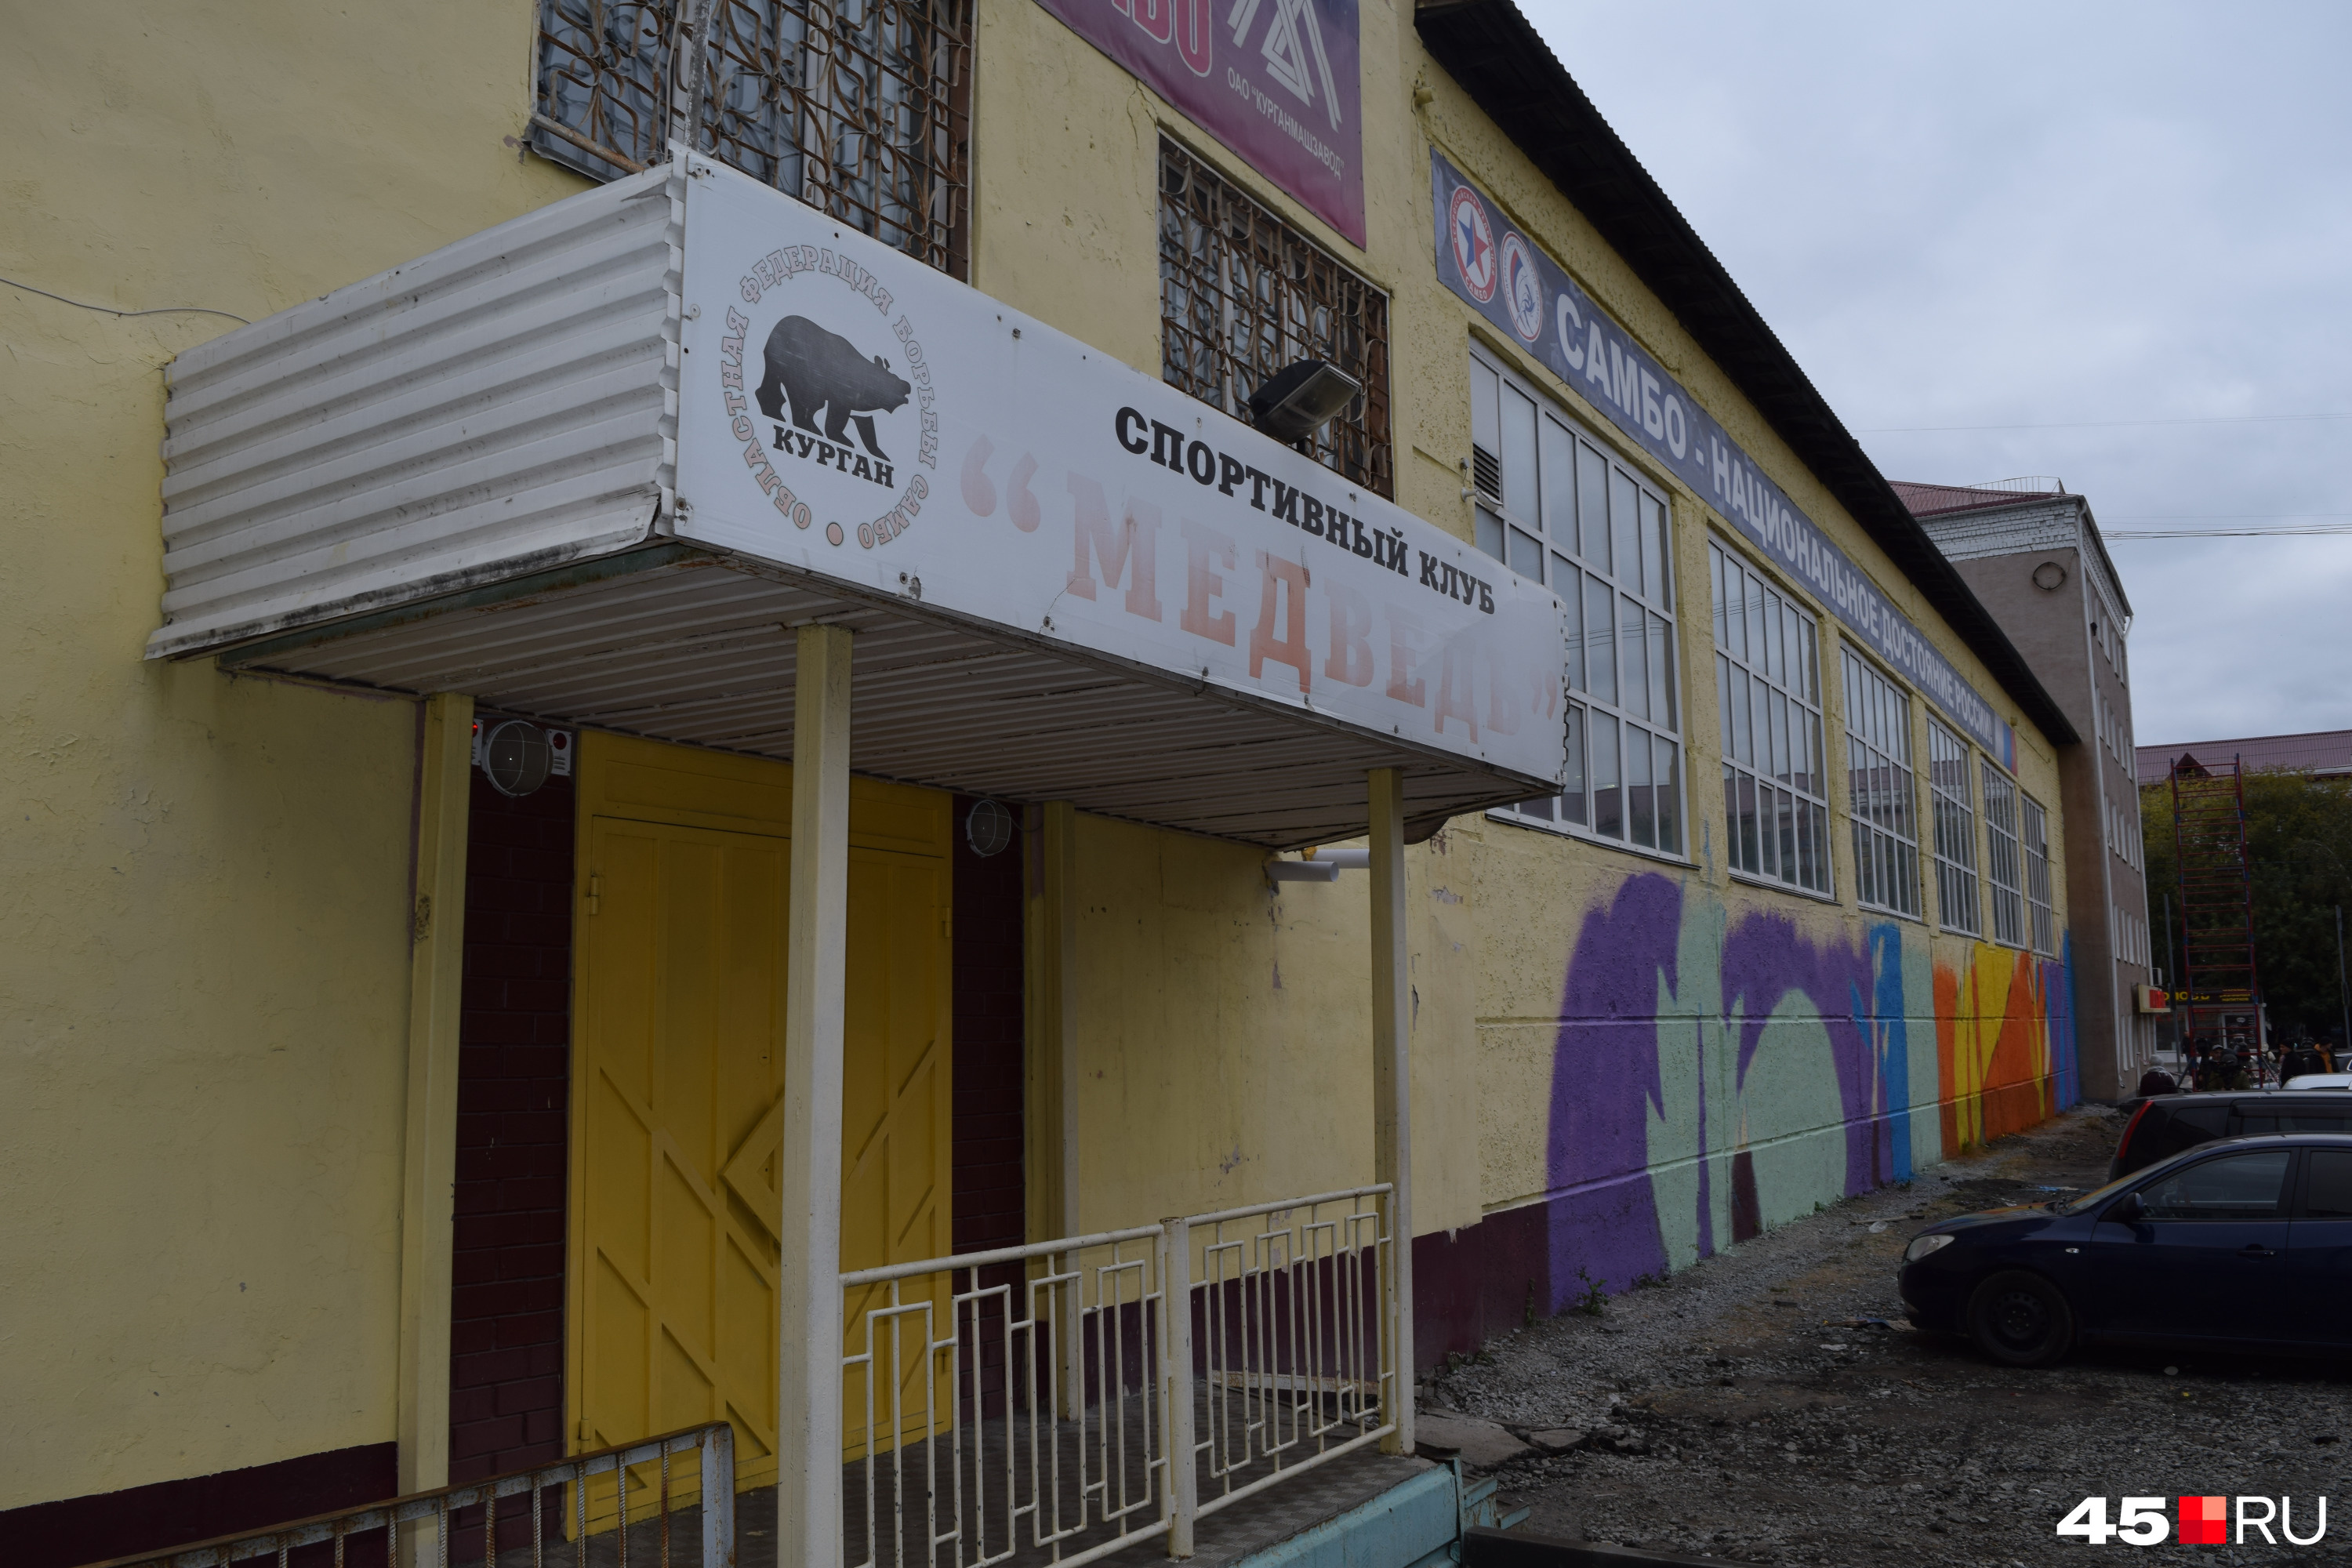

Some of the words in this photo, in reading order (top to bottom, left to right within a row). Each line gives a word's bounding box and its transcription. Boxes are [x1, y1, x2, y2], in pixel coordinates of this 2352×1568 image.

[1228, 67, 1250, 100] ОАО
[739, 245, 894, 316] ФЕДЕРАЦИЯ
[1465, 276, 1488, 300] САМБО
[721, 306, 811, 529] ОБЛАСТНАЯ
[892, 315, 938, 470] БОРЬБЫ
[773, 424, 895, 488] КУРГАН
[857, 474, 929, 550] САМБО
[1115, 406, 1410, 579] СПОРТИВНЫЙ
[1418, 550, 1495, 615] КЛУБ
[1557, 293, 1686, 460] САМБО
[1711, 435, 1880, 640] НАЦИОНАЛЬНОЕ
[1882, 606, 1955, 709] ДОСТОЯНИЕ
[1955, 679, 1993, 745] РОССИИ!
